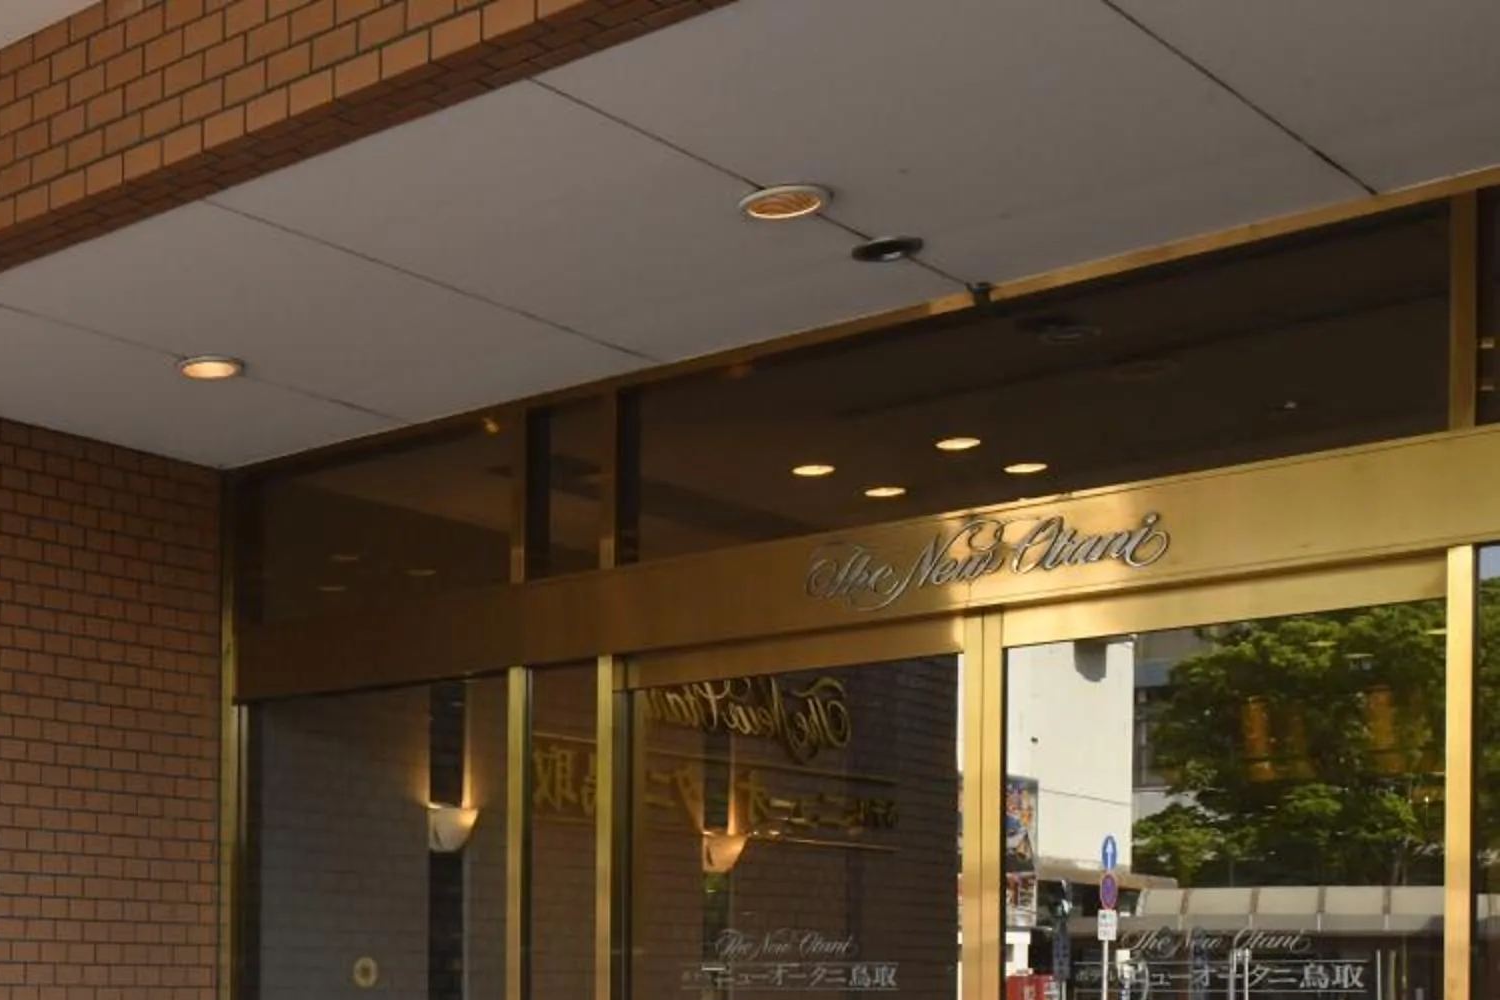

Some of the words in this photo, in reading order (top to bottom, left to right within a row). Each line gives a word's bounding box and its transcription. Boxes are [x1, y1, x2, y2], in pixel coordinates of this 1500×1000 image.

[805, 541, 900, 600] The
[850, 519, 1004, 611] New
[1002, 511, 1170, 575] Otani
